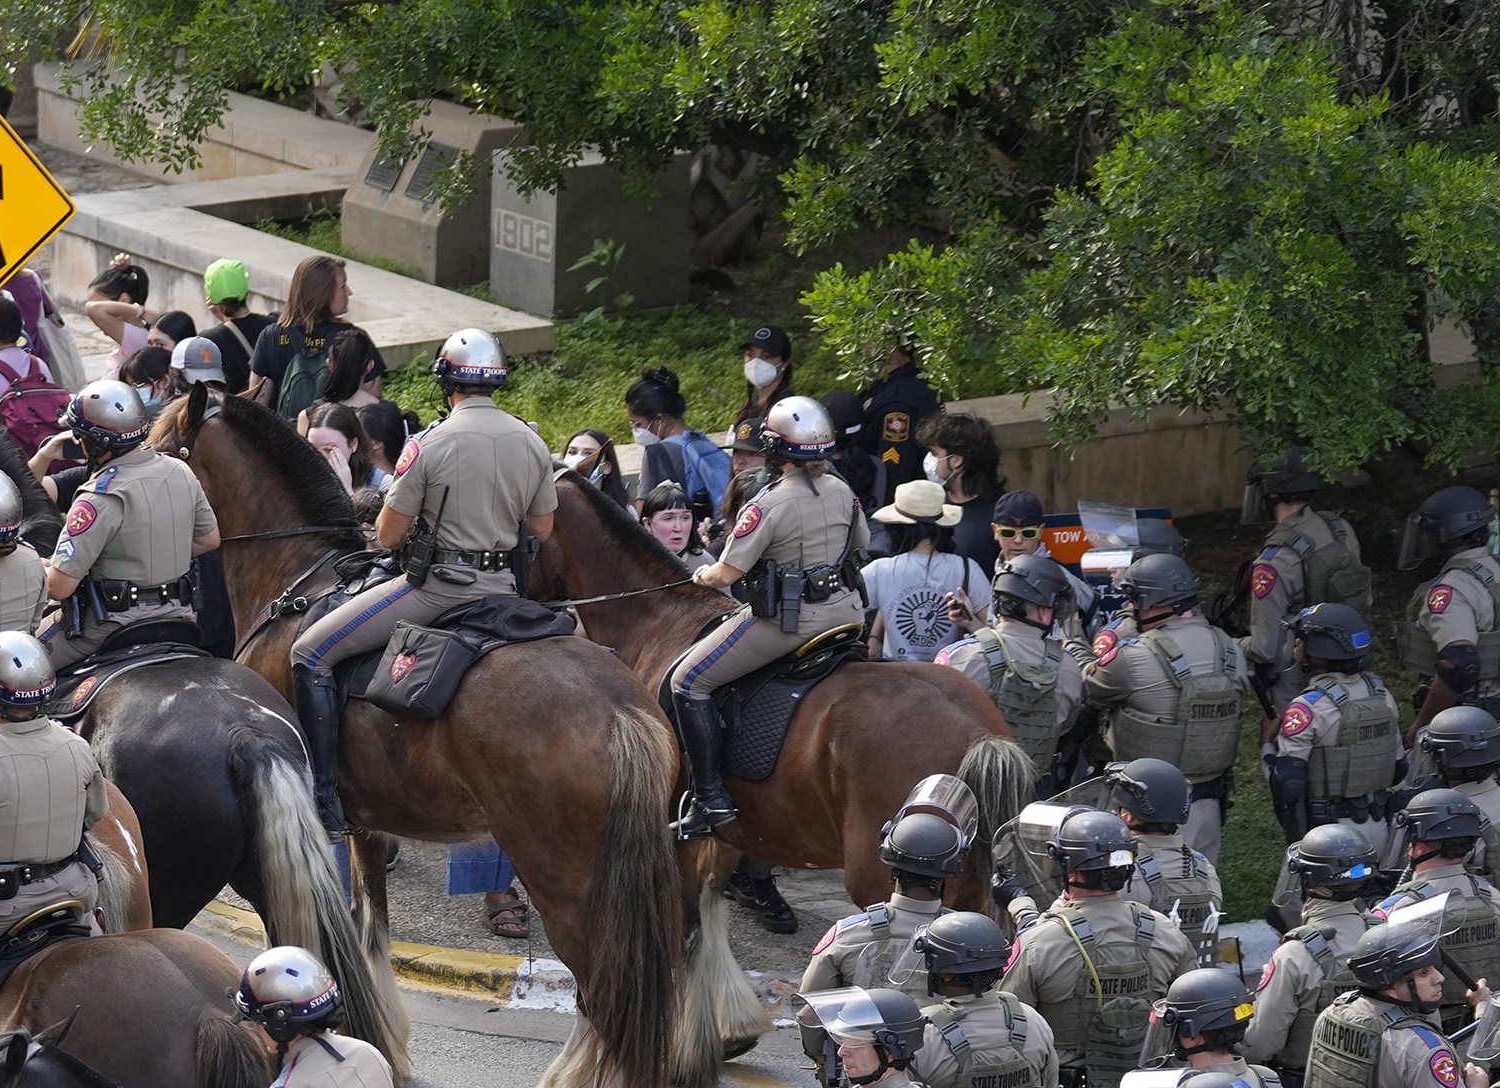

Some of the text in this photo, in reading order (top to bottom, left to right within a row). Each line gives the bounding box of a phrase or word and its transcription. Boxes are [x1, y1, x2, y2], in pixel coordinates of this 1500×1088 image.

[496, 210, 552, 261] 1902
[200, 350, 213, 363] T
[1053, 530, 1082, 544] TOW
[909, 634, 938, 648] SDS
[15, 690, 41, 698] STATE
[1191, 703, 1216, 719] STATE
[1471, 922, 1496, 942] POLICE
[1119, 973, 1148, 992] POLICE
[309, 991, 333, 1008] STATE
[1338, 1026, 1376, 1060] POLICE
